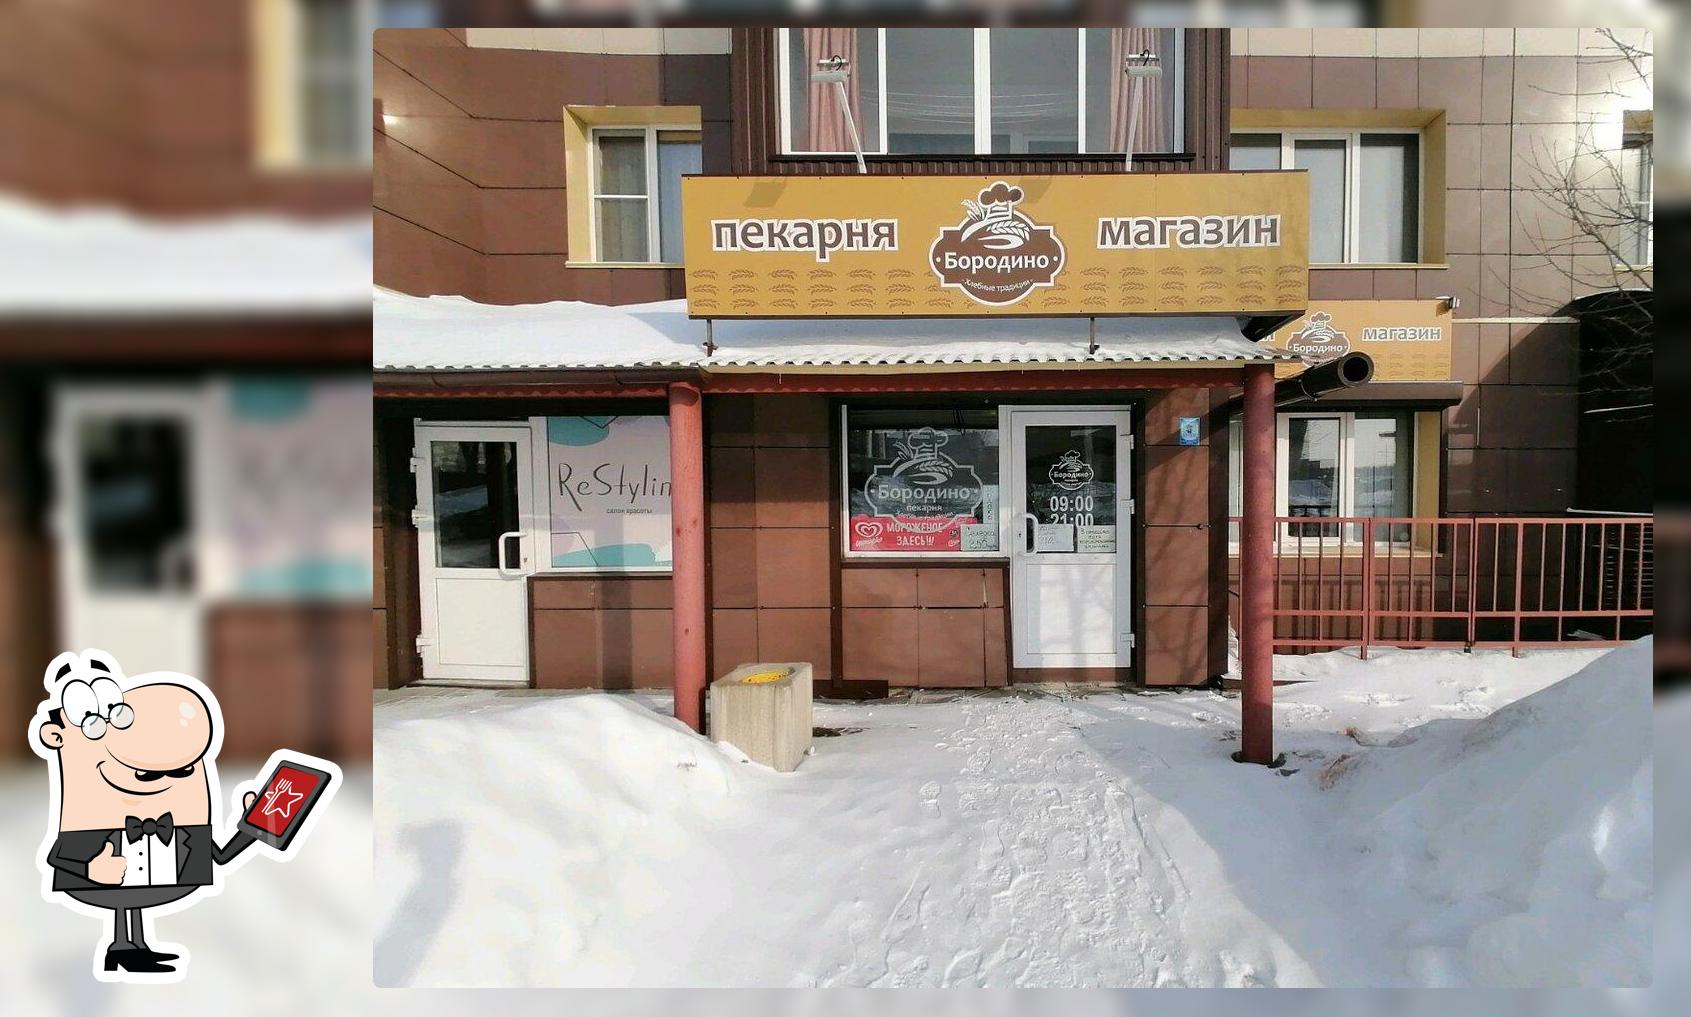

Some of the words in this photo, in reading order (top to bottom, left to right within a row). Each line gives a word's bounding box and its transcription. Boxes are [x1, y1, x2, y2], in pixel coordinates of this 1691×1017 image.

[1097, 214, 1281, 249] магазин
[711, 219, 898, 262] пекарня
[944, 252, 1050, 274] Бородино
[1362, 327, 1442, 342] магазин
[1293, 344, 1343, 354] Бородино
[1054, 471, 1089, 479] Бородино
[558, 463, 672, 511] ReStylin
[878, 485, 971, 503] Бородино
[906, 504, 943, 512] пекарня
[1050, 496, 1094, 512] 09:00
[1050, 513, 1094, 526] 21:00
